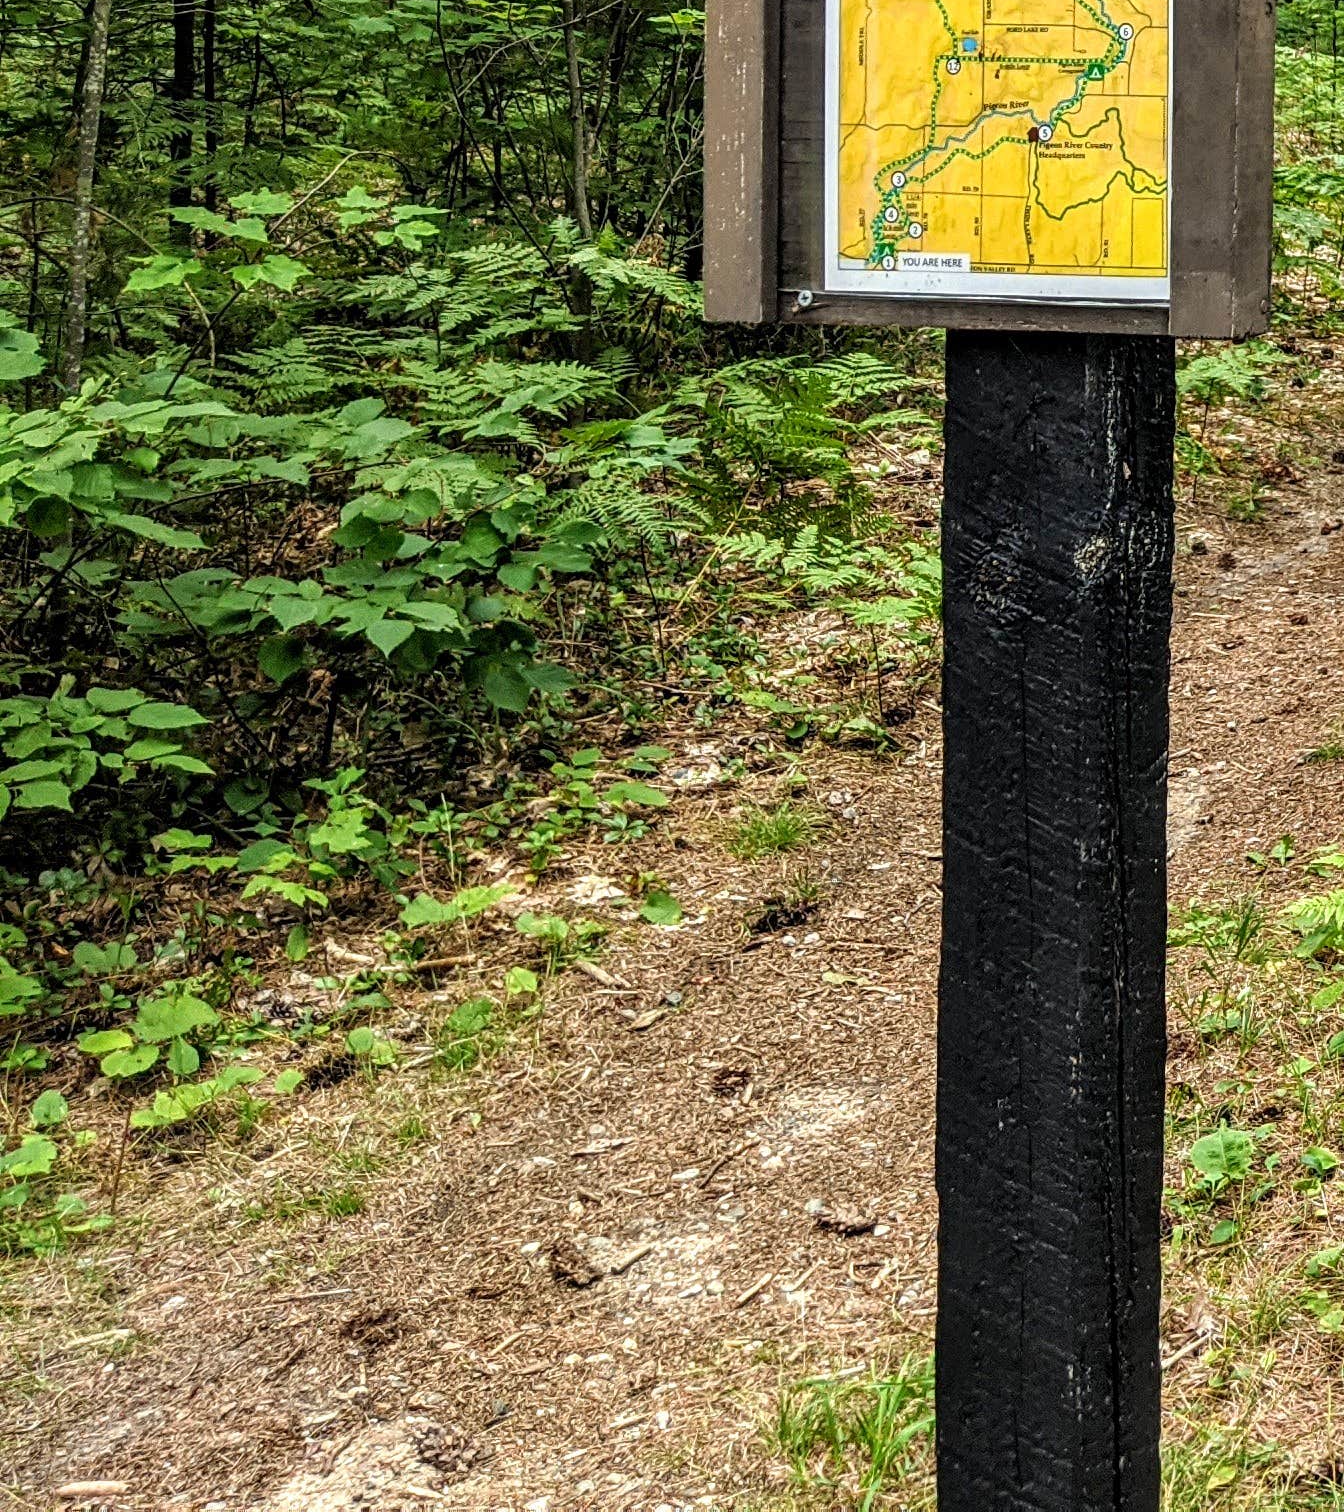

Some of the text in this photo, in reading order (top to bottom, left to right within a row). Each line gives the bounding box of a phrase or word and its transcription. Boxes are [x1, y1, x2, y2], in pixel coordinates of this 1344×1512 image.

[1010, 101, 1029, 109] River
[1039, 142, 1062, 150] Pigeon
[1085, 142, 1112, 150] Country
[1039, 152, 1085, 160] Headquarters
[903, 258, 963, 267] YOU ARE HERE
